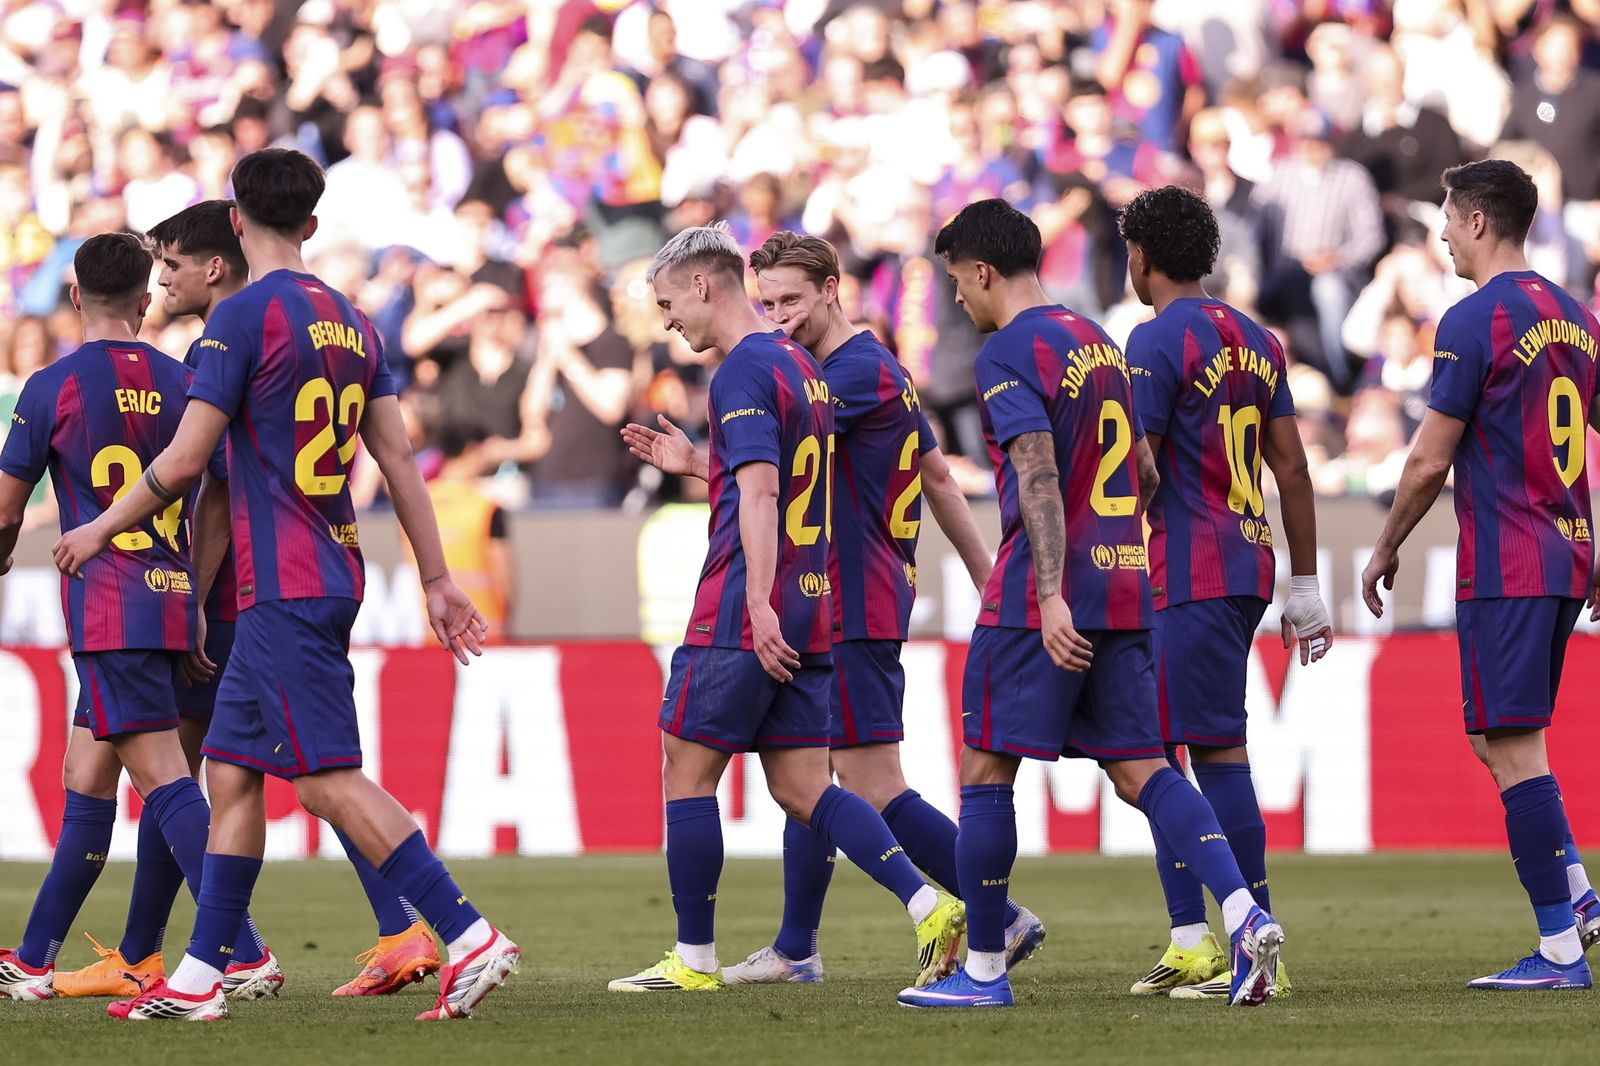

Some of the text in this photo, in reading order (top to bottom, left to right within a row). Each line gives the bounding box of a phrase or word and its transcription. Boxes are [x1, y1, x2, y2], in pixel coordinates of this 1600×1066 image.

[307, 320, 366, 358] BERNAL
[114, 388, 162, 416] ERIC
[294, 377, 366, 496] 22
[756, 408, 766, 416] tv
[1547, 376, 1585, 489] 9
[1089, 399, 1138, 517] 2
[1217, 404, 1264, 518] 10
[1116, 544, 1146, 556] UNHCR
